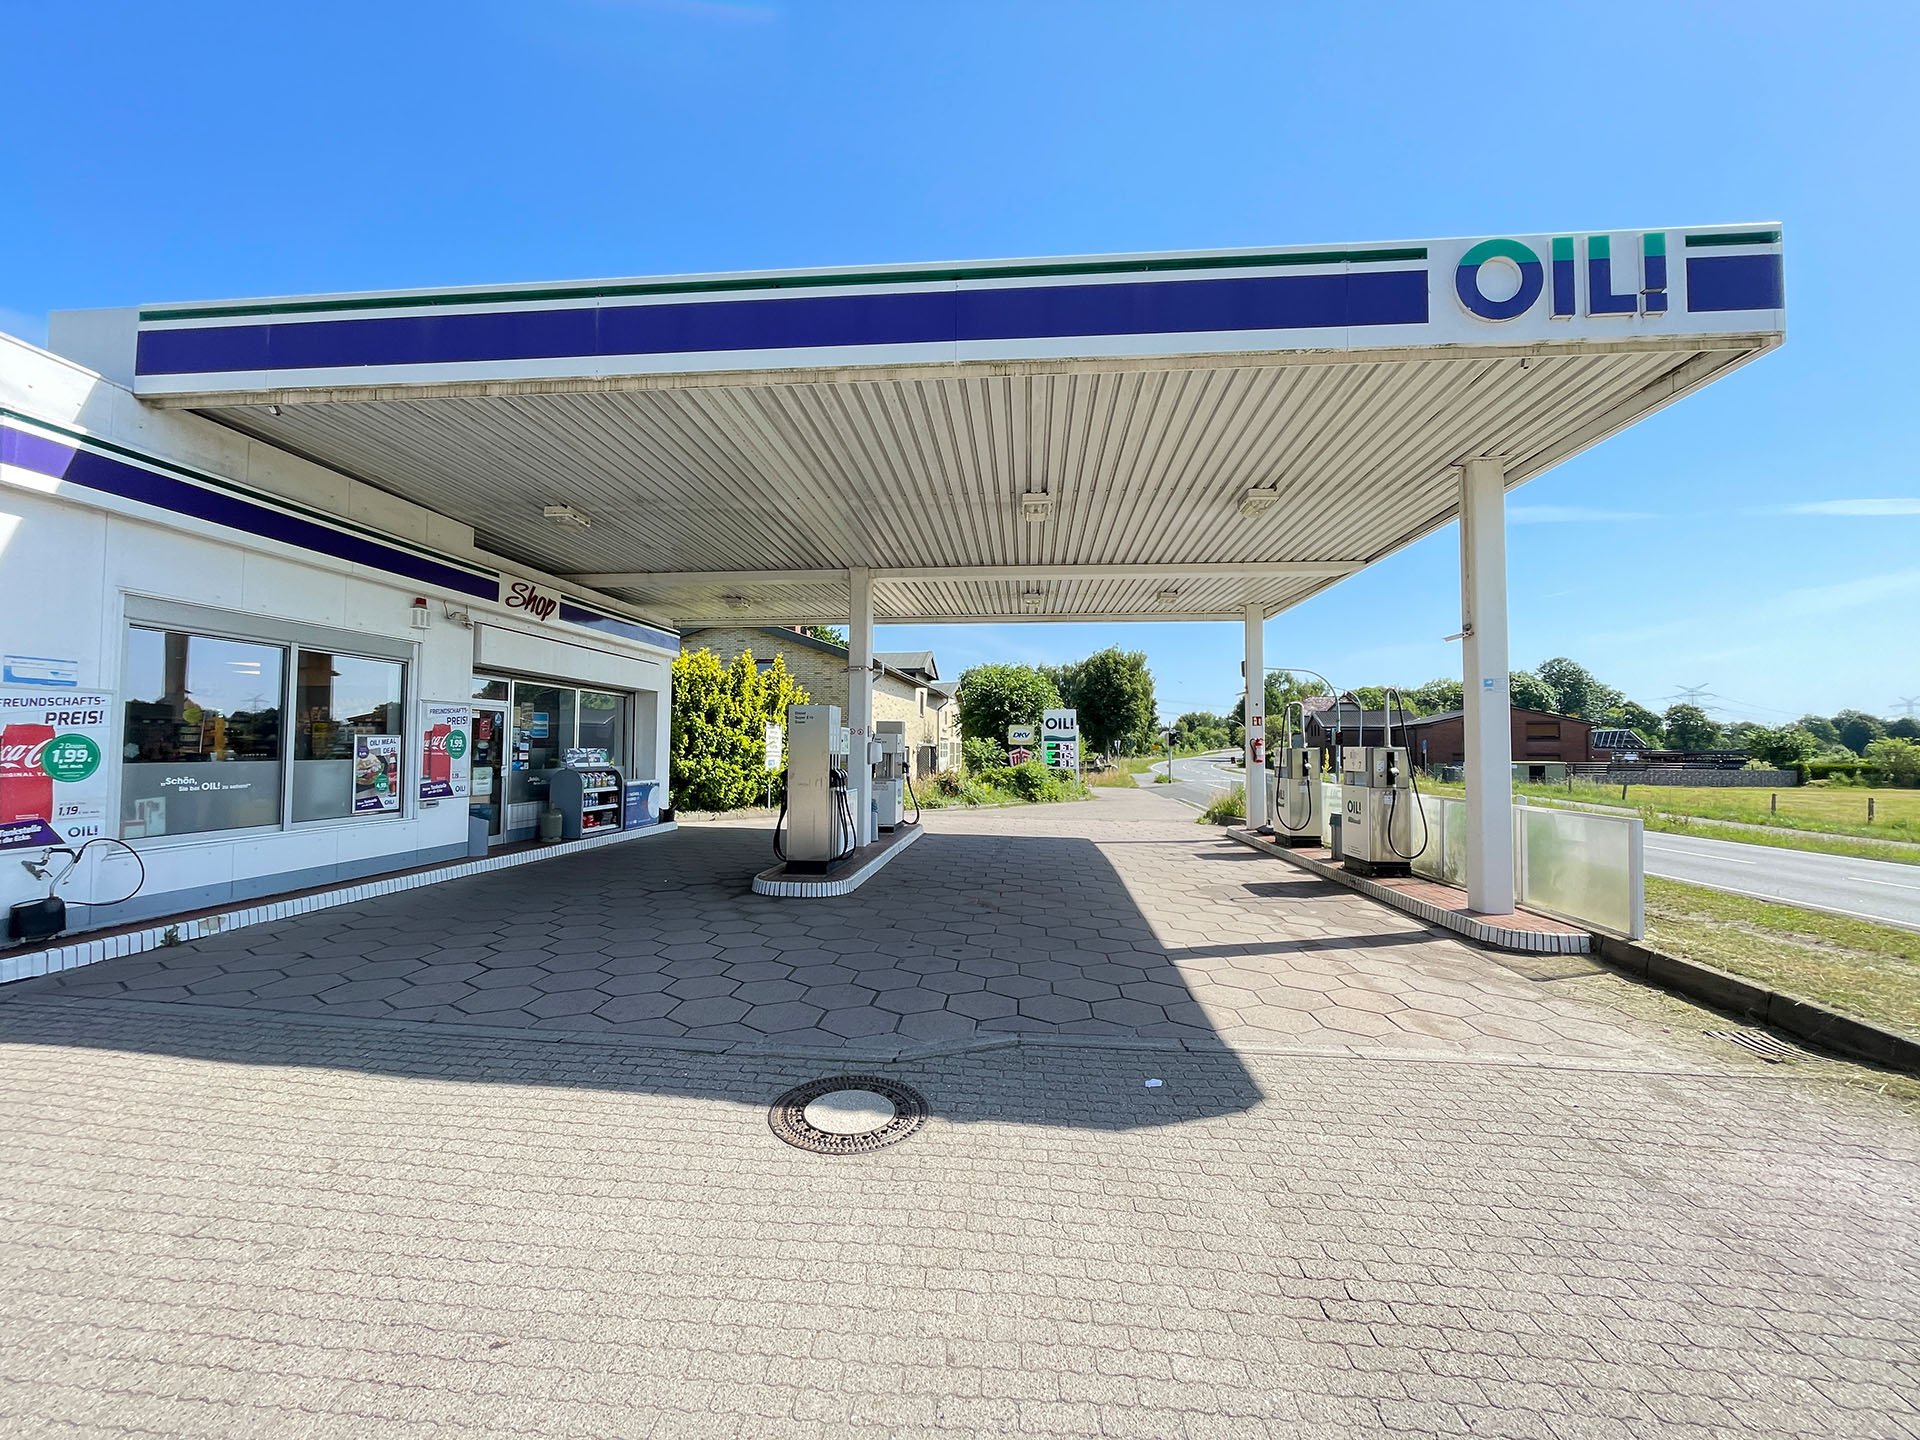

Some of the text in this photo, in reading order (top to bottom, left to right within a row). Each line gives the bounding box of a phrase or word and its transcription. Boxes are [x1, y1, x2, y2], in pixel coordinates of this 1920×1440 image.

[1454, 232, 1668, 322] OIL!
[505, 582, 557, 622] Shop
[45, 711, 104, 725] PREIS!
[1045, 718, 1074, 729] OIL!
[52, 749, 89, 764] 1,99
[201, 782, 220, 791] OIL!
[58, 806, 79, 816] 1,19
[1347, 800, 1361, 814] OIL!
[68, 825, 99, 838] OIL!
